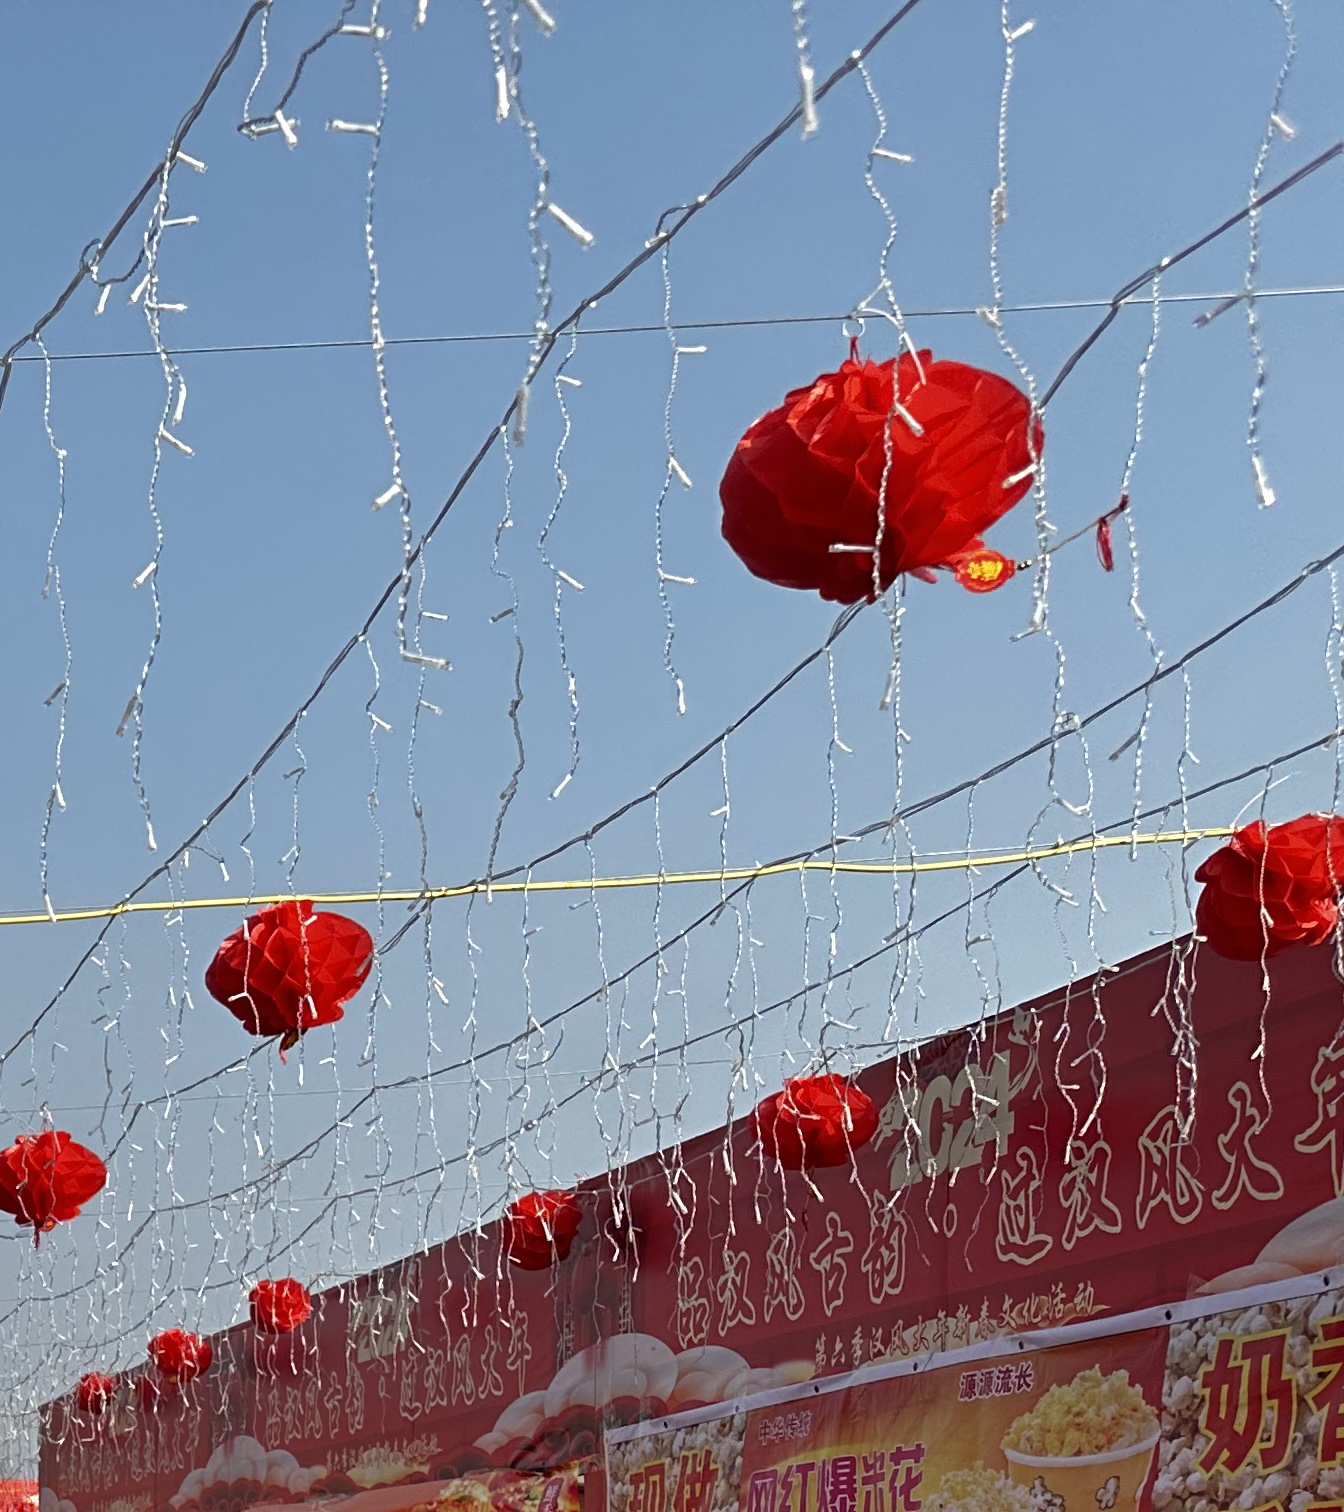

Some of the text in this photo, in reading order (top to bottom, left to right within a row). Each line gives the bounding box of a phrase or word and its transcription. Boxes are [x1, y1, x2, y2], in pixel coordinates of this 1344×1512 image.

[958, 1363, 1034, 1402] 源源流长
[758, 1410, 812, 1445] 中华传统
